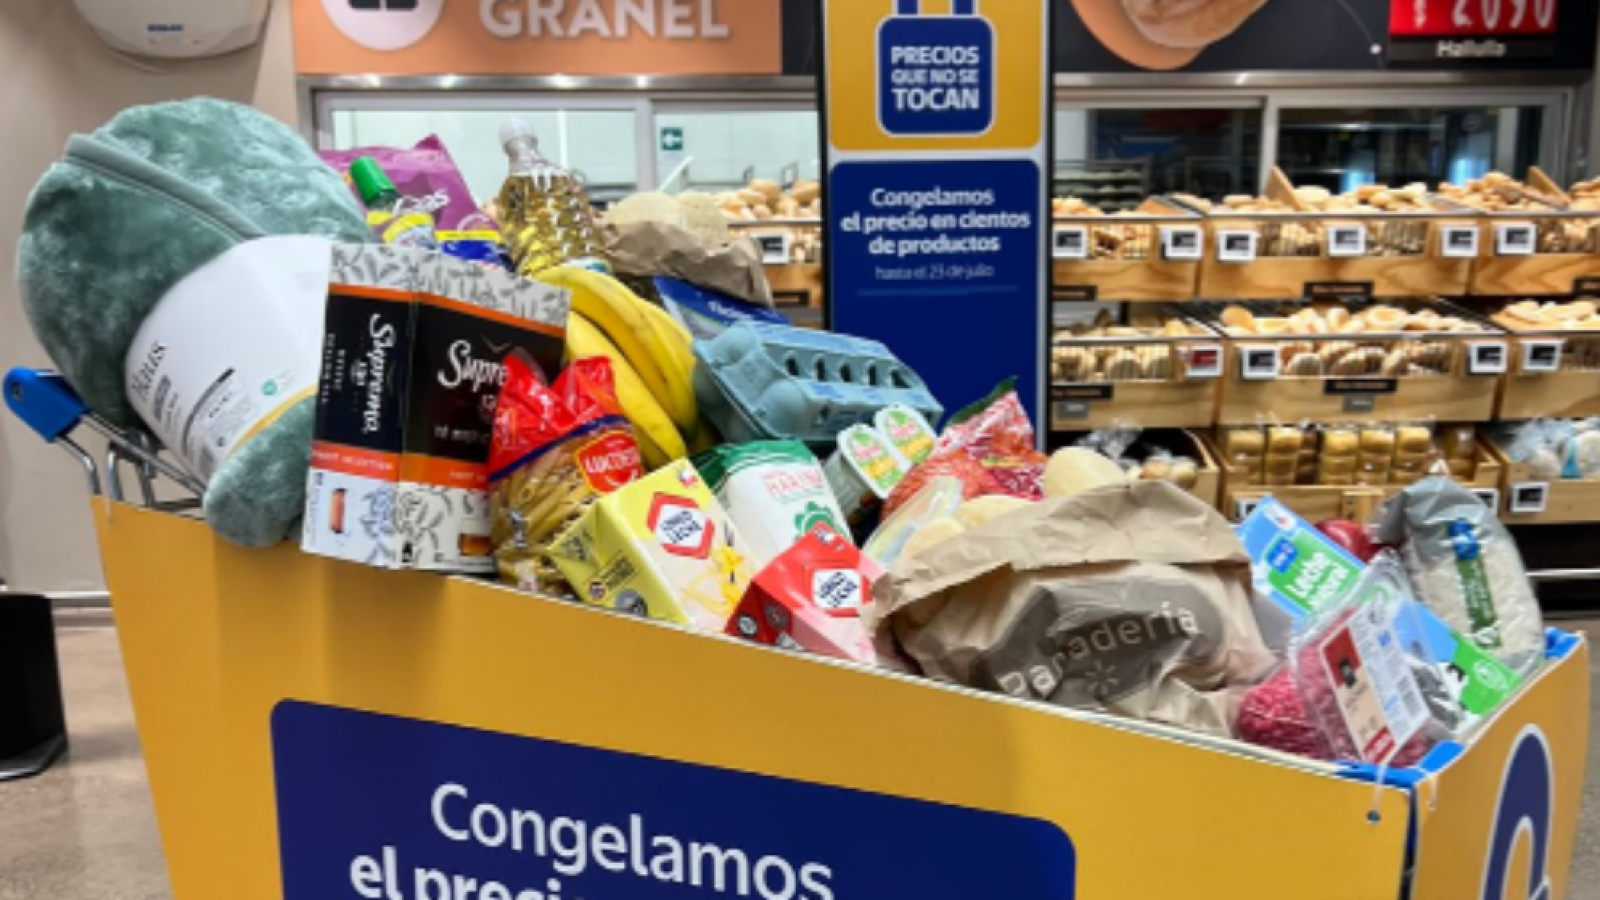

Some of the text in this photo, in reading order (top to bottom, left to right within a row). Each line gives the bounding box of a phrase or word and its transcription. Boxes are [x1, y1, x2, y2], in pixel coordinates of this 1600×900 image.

[479, 0, 730, 39] GRANEL
[891, 46, 980, 65] PRECIOS
[891, 68, 980, 84] QUE NO SE
[891, 88, 980, 111] TOCAN
[870, 186, 995, 210] Congelamos
[840, 210, 1031, 235] el precio en cientos
[868, 234, 1001, 258] de productos
[437, 339, 509, 392] Supre
[430, 782, 836, 900] Congelamos
[350, 845, 403, 900] el
